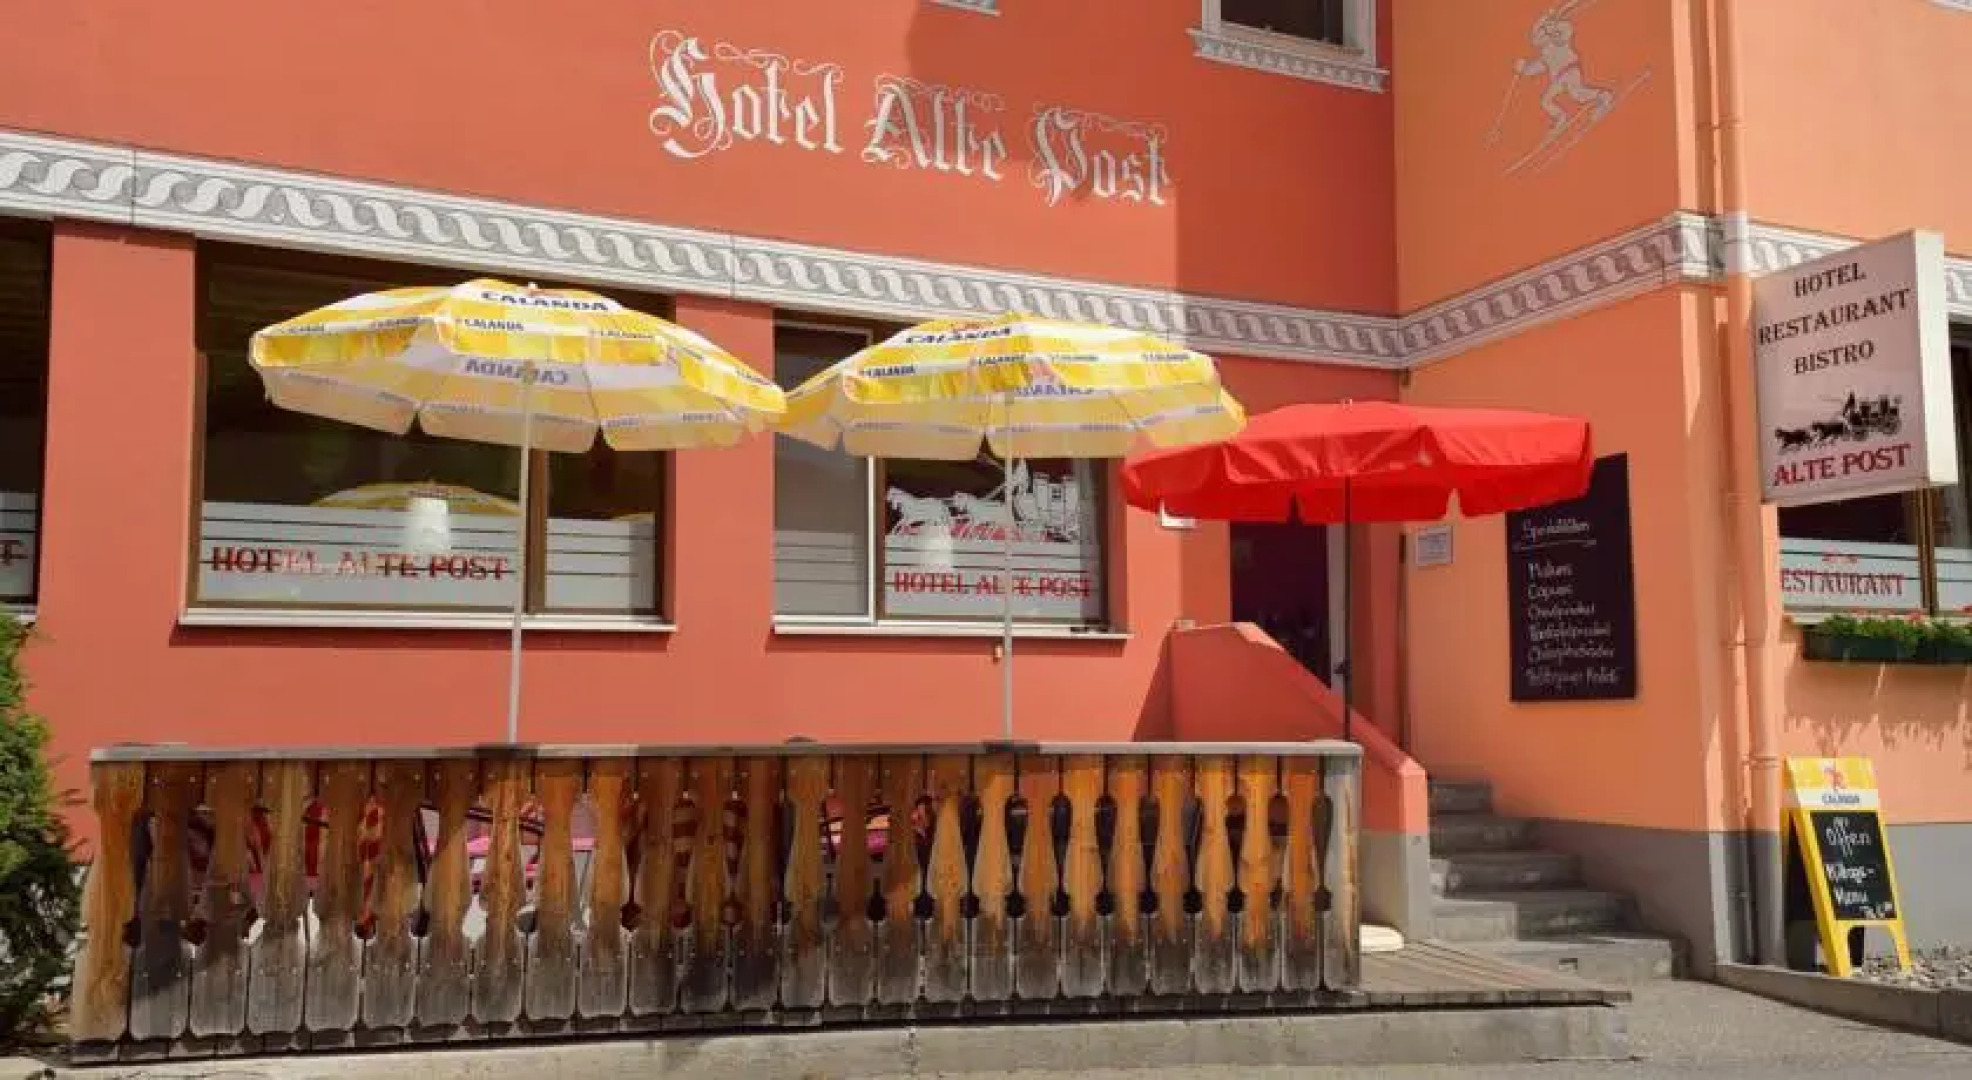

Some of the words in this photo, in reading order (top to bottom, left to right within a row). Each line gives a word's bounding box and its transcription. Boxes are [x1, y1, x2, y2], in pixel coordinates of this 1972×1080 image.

[649, 29, 846, 158] Hotel
[861, 73, 1008, 182] Alte
[1026, 101, 1174, 206] Post
[1795, 262, 1867, 297] HOTEL
[481, 291, 609, 311] CALANDA
[1758, 288, 1911, 346] RESTAURANT
[1795, 339, 1875, 375] BISTRO
[1774, 456, 1836, 486] ALTE
[1842, 443, 1912, 475] POST
[211, 546, 322, 575] HOTEL
[428, 554, 508, 580] POST
[894, 572, 967, 595] HOTEL
[1039, 576, 1091, 597] POST
[1781, 568, 1904, 597] ESTAURANT
